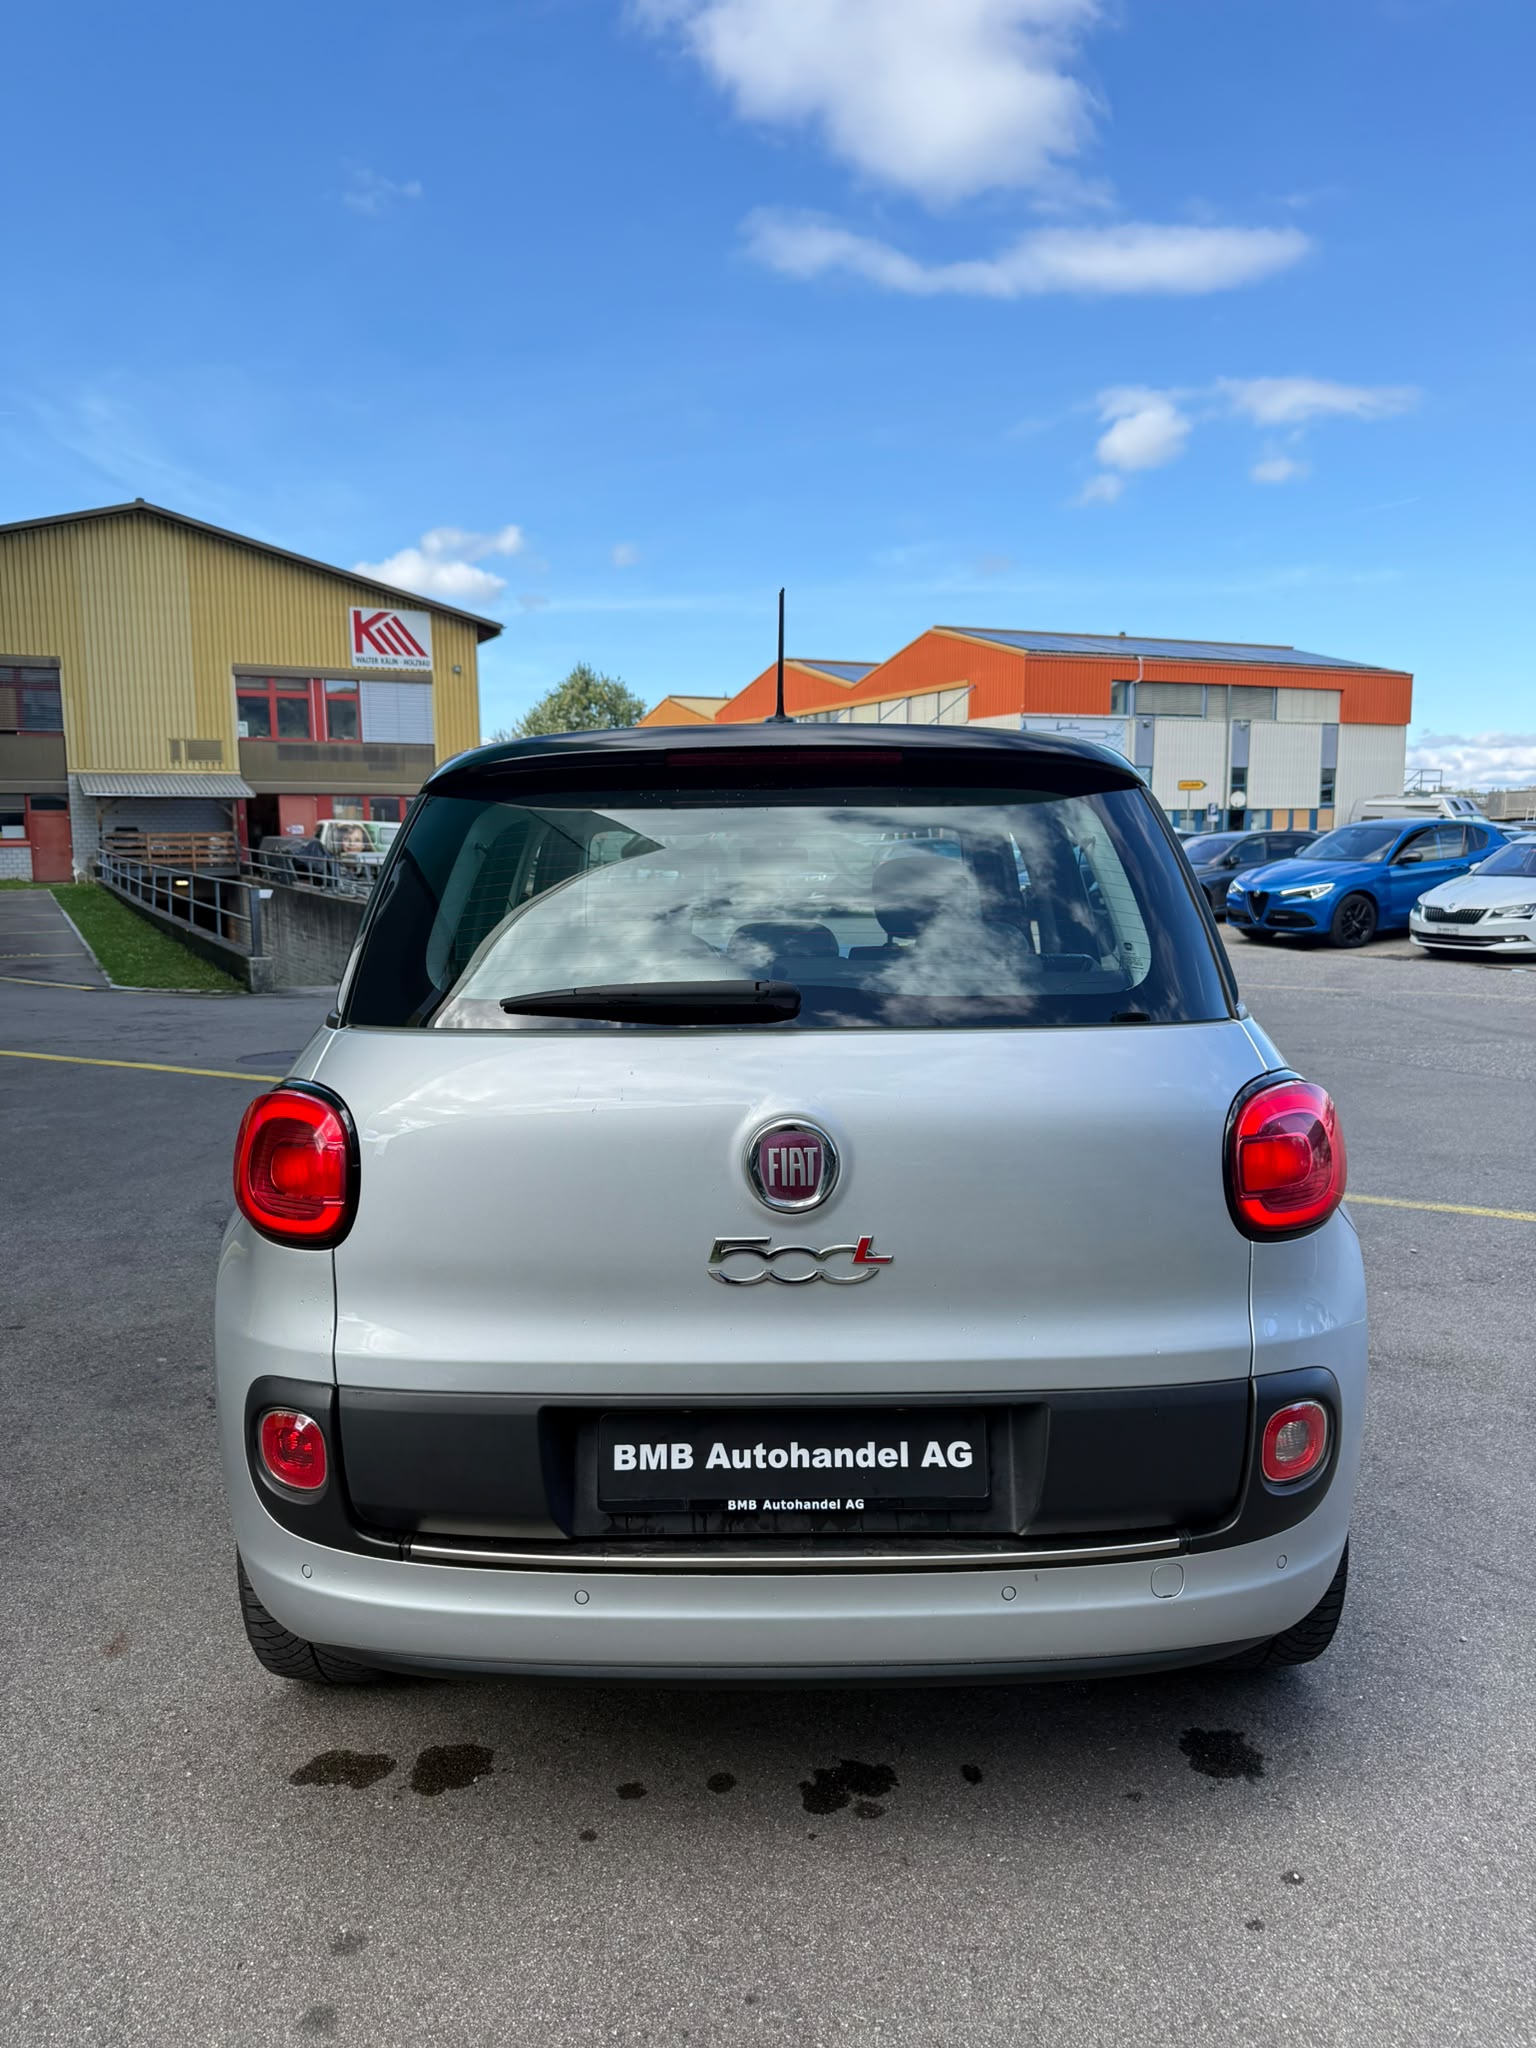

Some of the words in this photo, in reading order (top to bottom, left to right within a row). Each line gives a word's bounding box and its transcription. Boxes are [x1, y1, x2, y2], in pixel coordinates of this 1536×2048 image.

[355, 656, 378, 664] WALTER
[403, 659, 431, 667] HOLZBAU
[767, 1147, 818, 1187] FIAT
[613, 1443, 694, 1471] BMB
[705, 1441, 909, 1469] Autohandel
[920, 1440, 973, 1468] AG
[727, 1499, 757, 1511] BMB
[762, 1498, 841, 1511] Autohandel
[845, 1498, 865, 1510] AG
